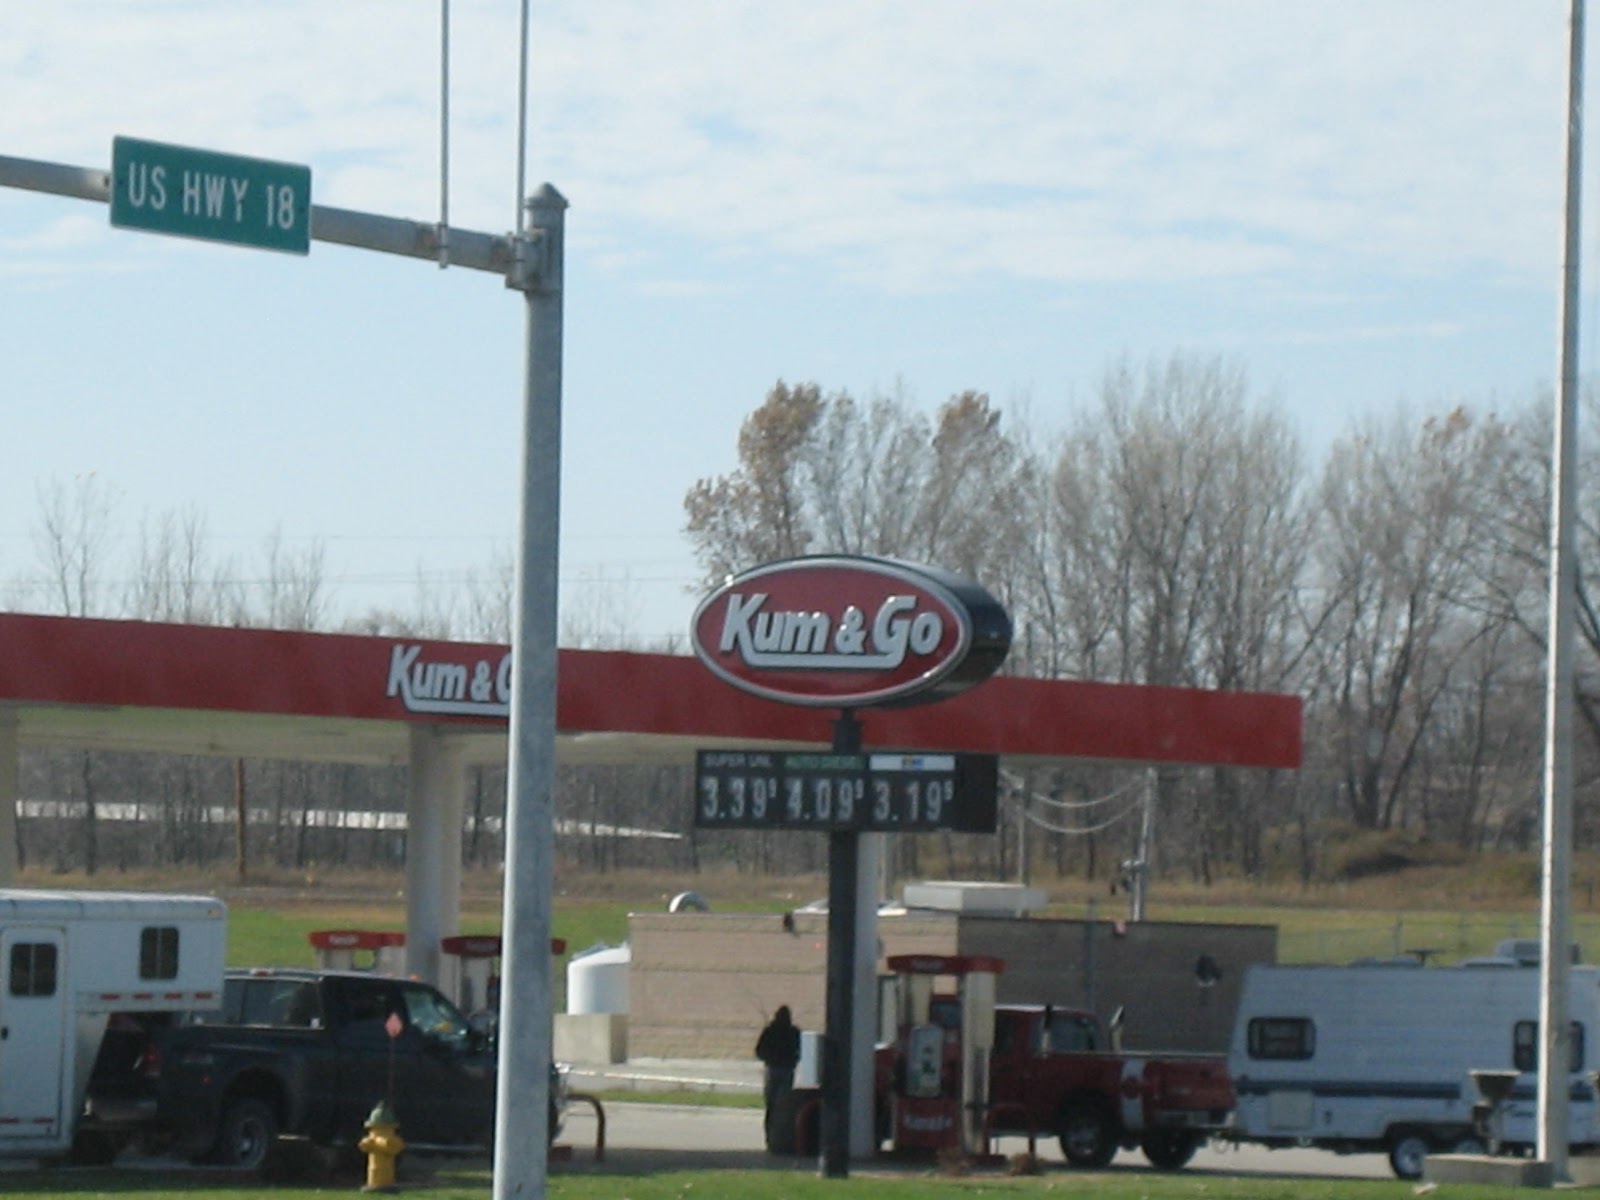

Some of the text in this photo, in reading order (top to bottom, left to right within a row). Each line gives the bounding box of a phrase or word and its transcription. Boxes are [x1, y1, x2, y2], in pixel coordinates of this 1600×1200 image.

[128, 161, 295, 230] US HWY 18
[719, 592, 943, 658] Kum & Go
[386, 643, 468, 703] Kum
[470, 659, 492, 702] &
